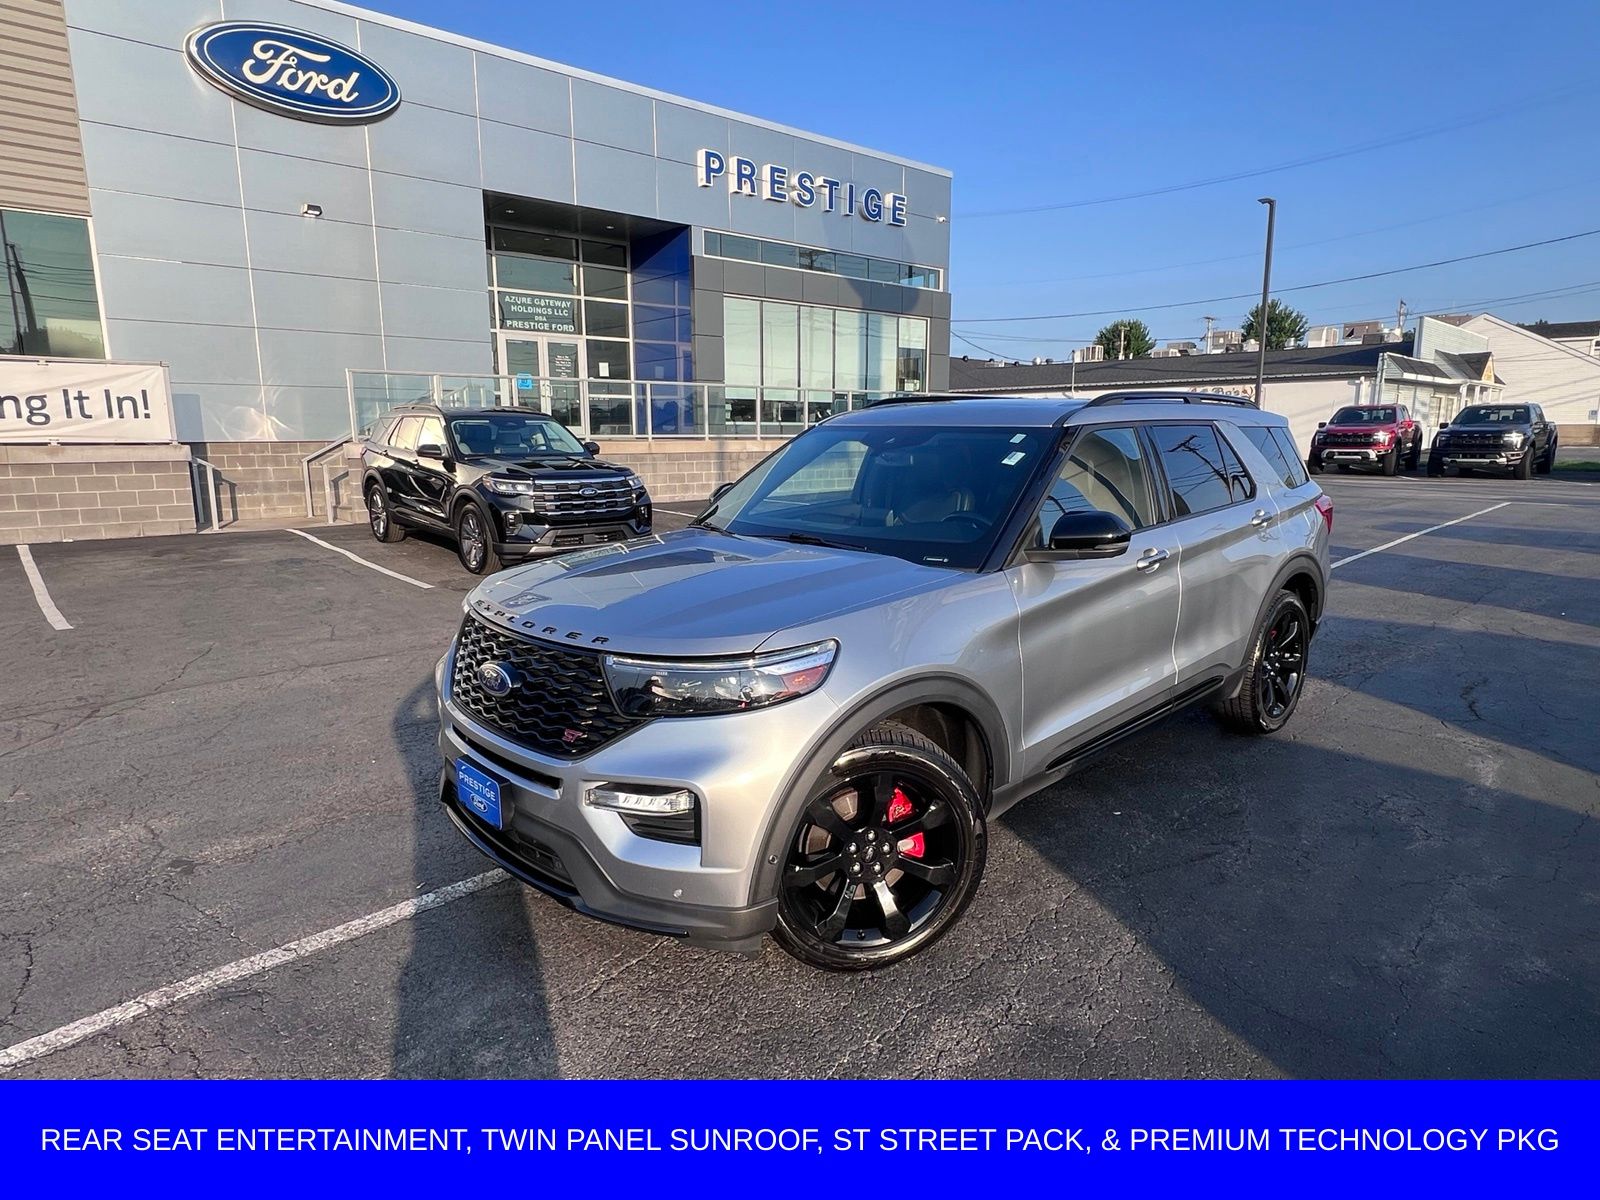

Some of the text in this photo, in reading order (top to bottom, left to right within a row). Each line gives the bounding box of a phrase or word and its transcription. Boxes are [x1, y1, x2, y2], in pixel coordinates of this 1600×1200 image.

[242, 40, 360, 102] Ford
[697, 149, 907, 227] PRESTIGE
[505, 295, 571, 308] AZURE GATEWAY
[511, 305, 553, 315] HOLDINGS
[506, 320, 575, 332] PRESTIGE FORD
[0, 389, 151, 425] ng It In!
[475, 600, 610, 645] EXPLORER
[562, 728, 584, 742] ST
[458, 771, 496, 802] PRESTIGE
[471, 795, 486, 811] Ford
